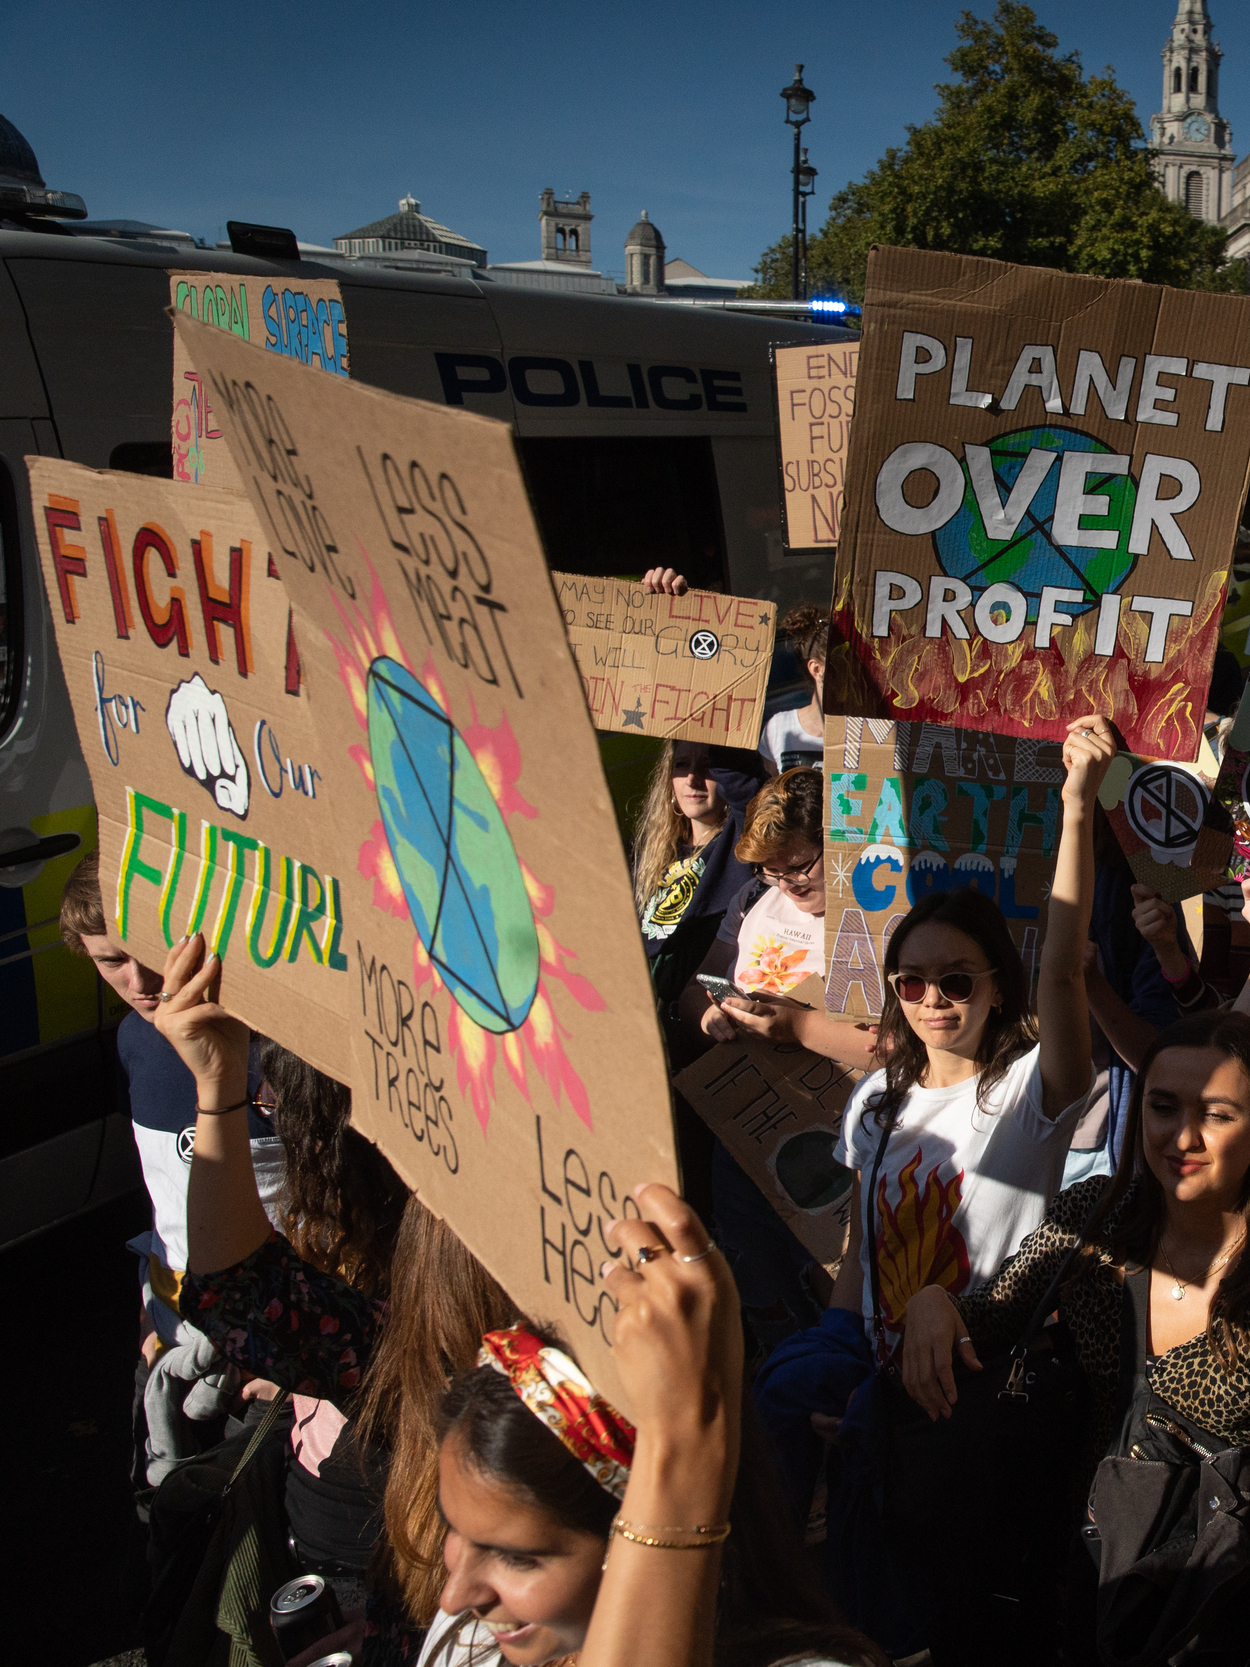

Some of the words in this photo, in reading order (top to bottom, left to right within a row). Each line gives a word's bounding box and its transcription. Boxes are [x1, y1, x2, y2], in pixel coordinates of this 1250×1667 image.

[262, 284, 349, 379] SURFACE
[434, 353, 748, 413] POLICE
[875, 441, 1201, 561] OVER
[559, 581, 605, 604] MAY
[616, 588, 656, 609] NOT
[669, 593, 758, 630] LIVE
[586, 612, 615, 631] SEE
[623, 616, 656, 636] OUR
[655, 626, 760, 668] GLRY
[871, 570, 1193, 664] PROFIT
[593, 645, 645, 669] WILL
[93, 651, 146, 766] for
[254, 720, 322, 799] Our
[632, 683, 651, 694] THE
[651, 683, 757, 732] FIGHT
[830, 773, 1060, 858] EARTH
[852, 844, 1040, 919] COOL
[784, 928, 812, 940] HAWAII
[704, 1054, 762, 1097] IF
[733, 1079, 798, 1144] THE
